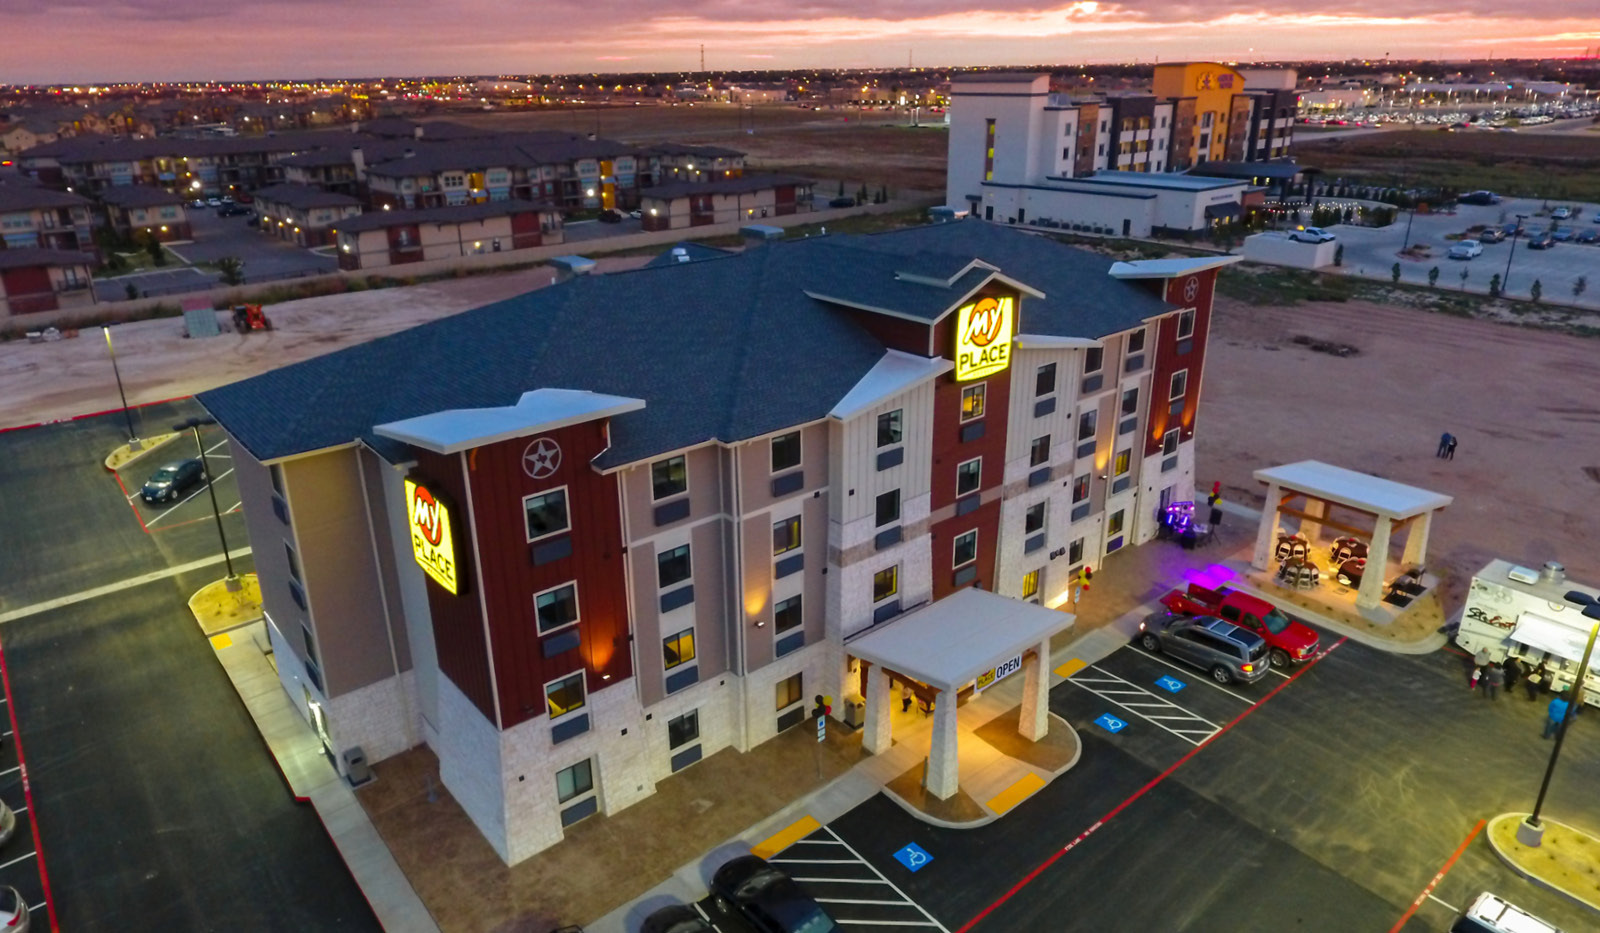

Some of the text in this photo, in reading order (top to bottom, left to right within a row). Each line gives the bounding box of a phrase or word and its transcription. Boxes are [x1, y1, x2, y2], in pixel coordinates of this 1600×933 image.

[960, 343, 1007, 371] PLACE
[414, 534, 454, 581] PLACE
[996, 655, 1020, 679] OPEN
